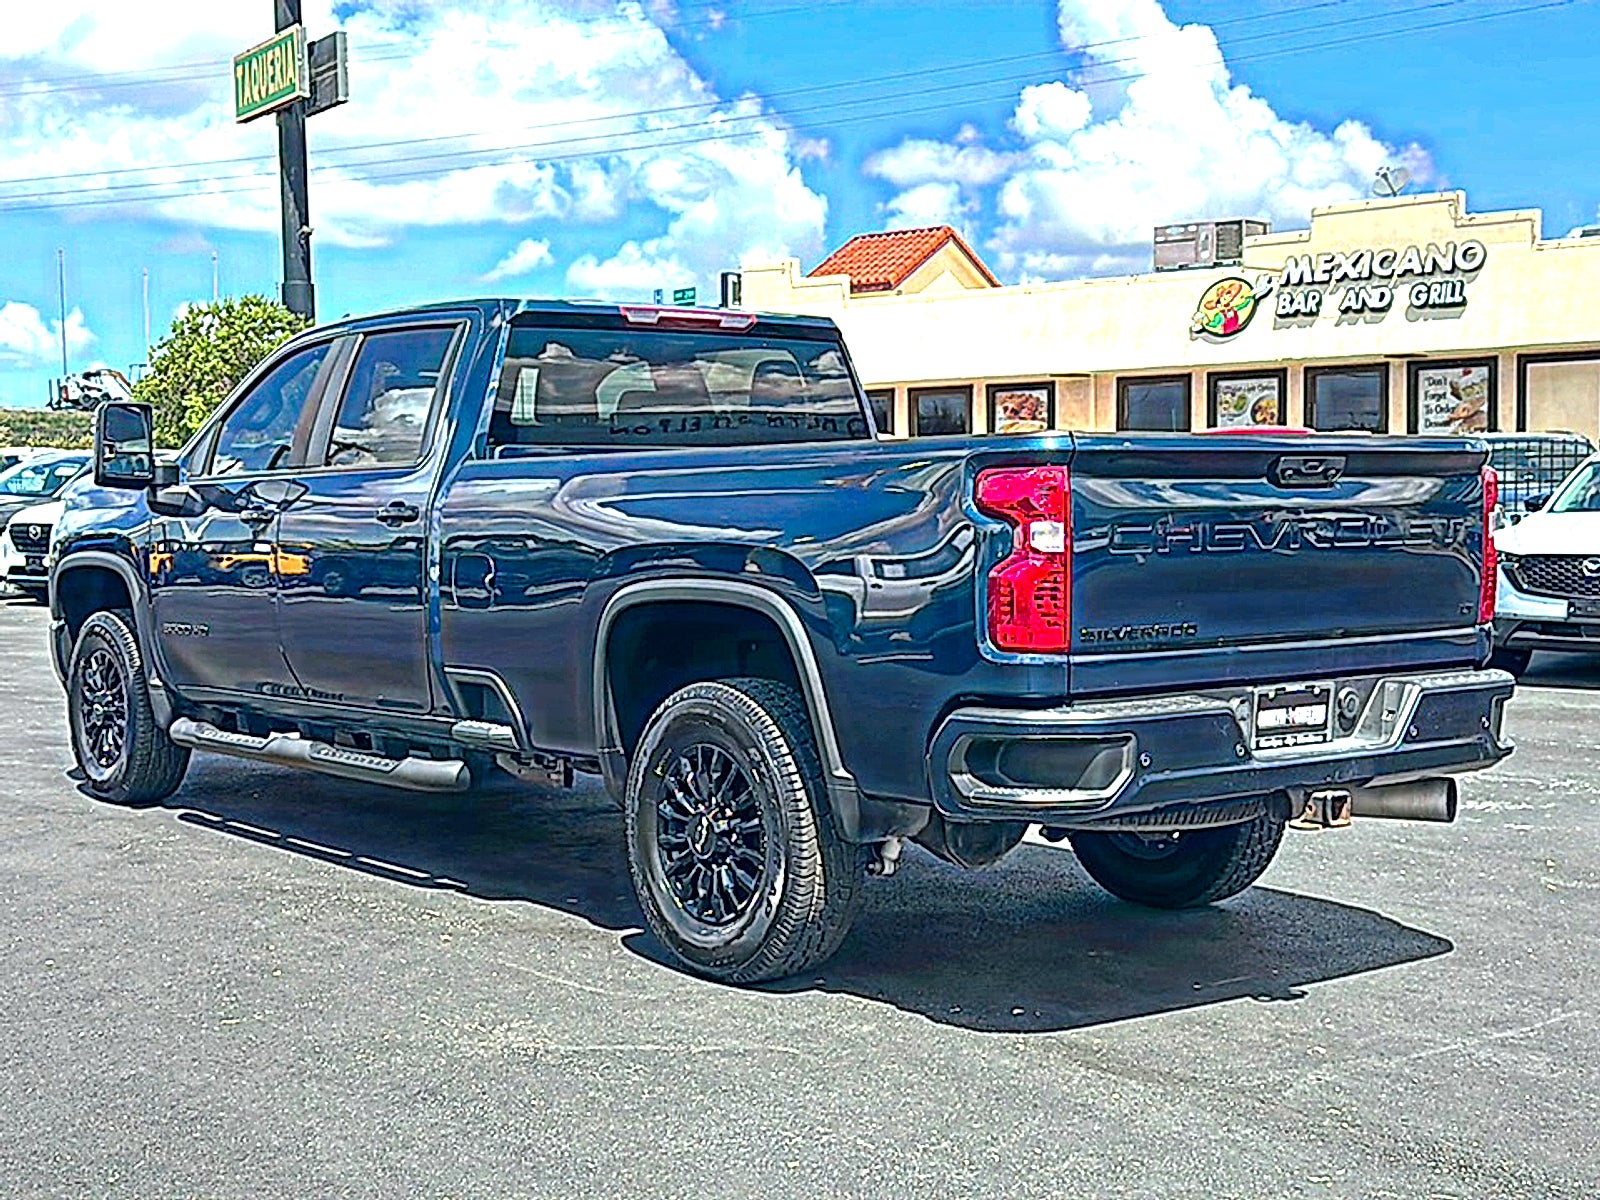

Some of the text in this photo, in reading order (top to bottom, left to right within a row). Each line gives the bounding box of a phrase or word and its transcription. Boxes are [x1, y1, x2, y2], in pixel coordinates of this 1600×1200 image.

[236, 40, 295, 107] TAQUERIA
[1279, 240, 1486, 286] MEXICANO
[1276, 281, 1467, 317] BAR AND GRILL
[1108, 516, 1470, 554] CHEVROLET
